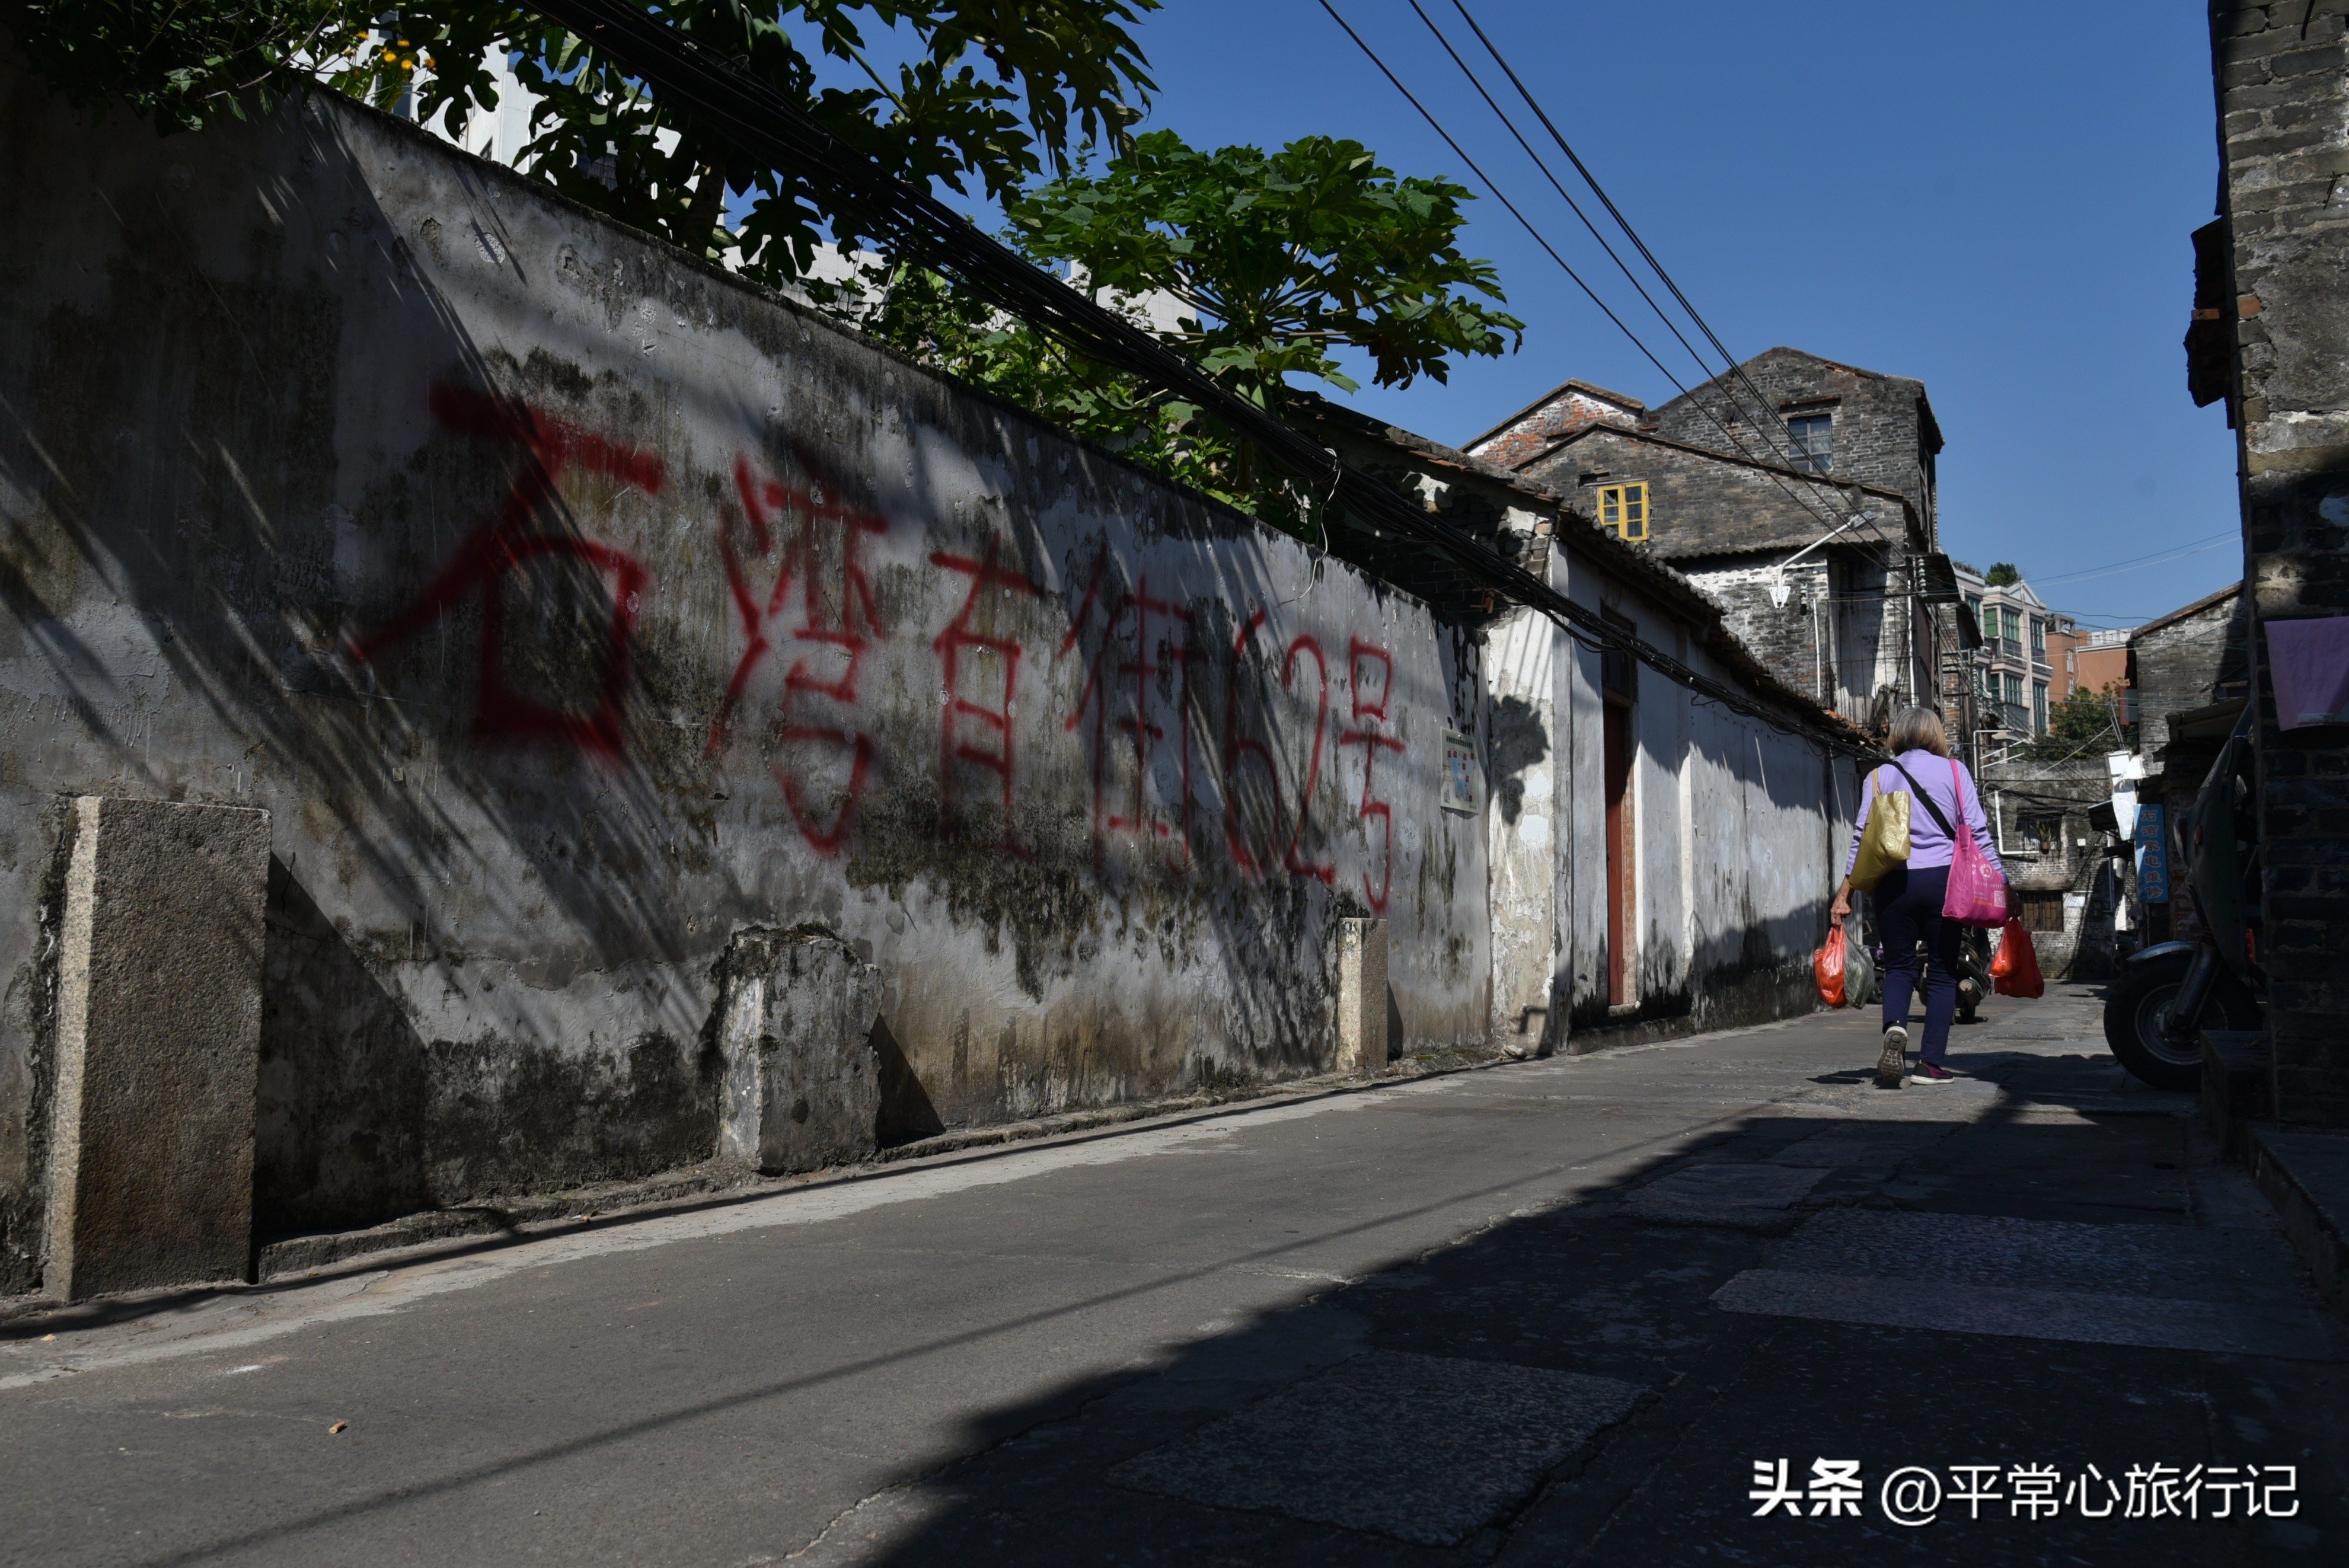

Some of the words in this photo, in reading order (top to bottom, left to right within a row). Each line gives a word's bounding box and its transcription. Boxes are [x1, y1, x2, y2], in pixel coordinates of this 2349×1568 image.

[2141, 810, 2163, 898] 石湾家电维修
